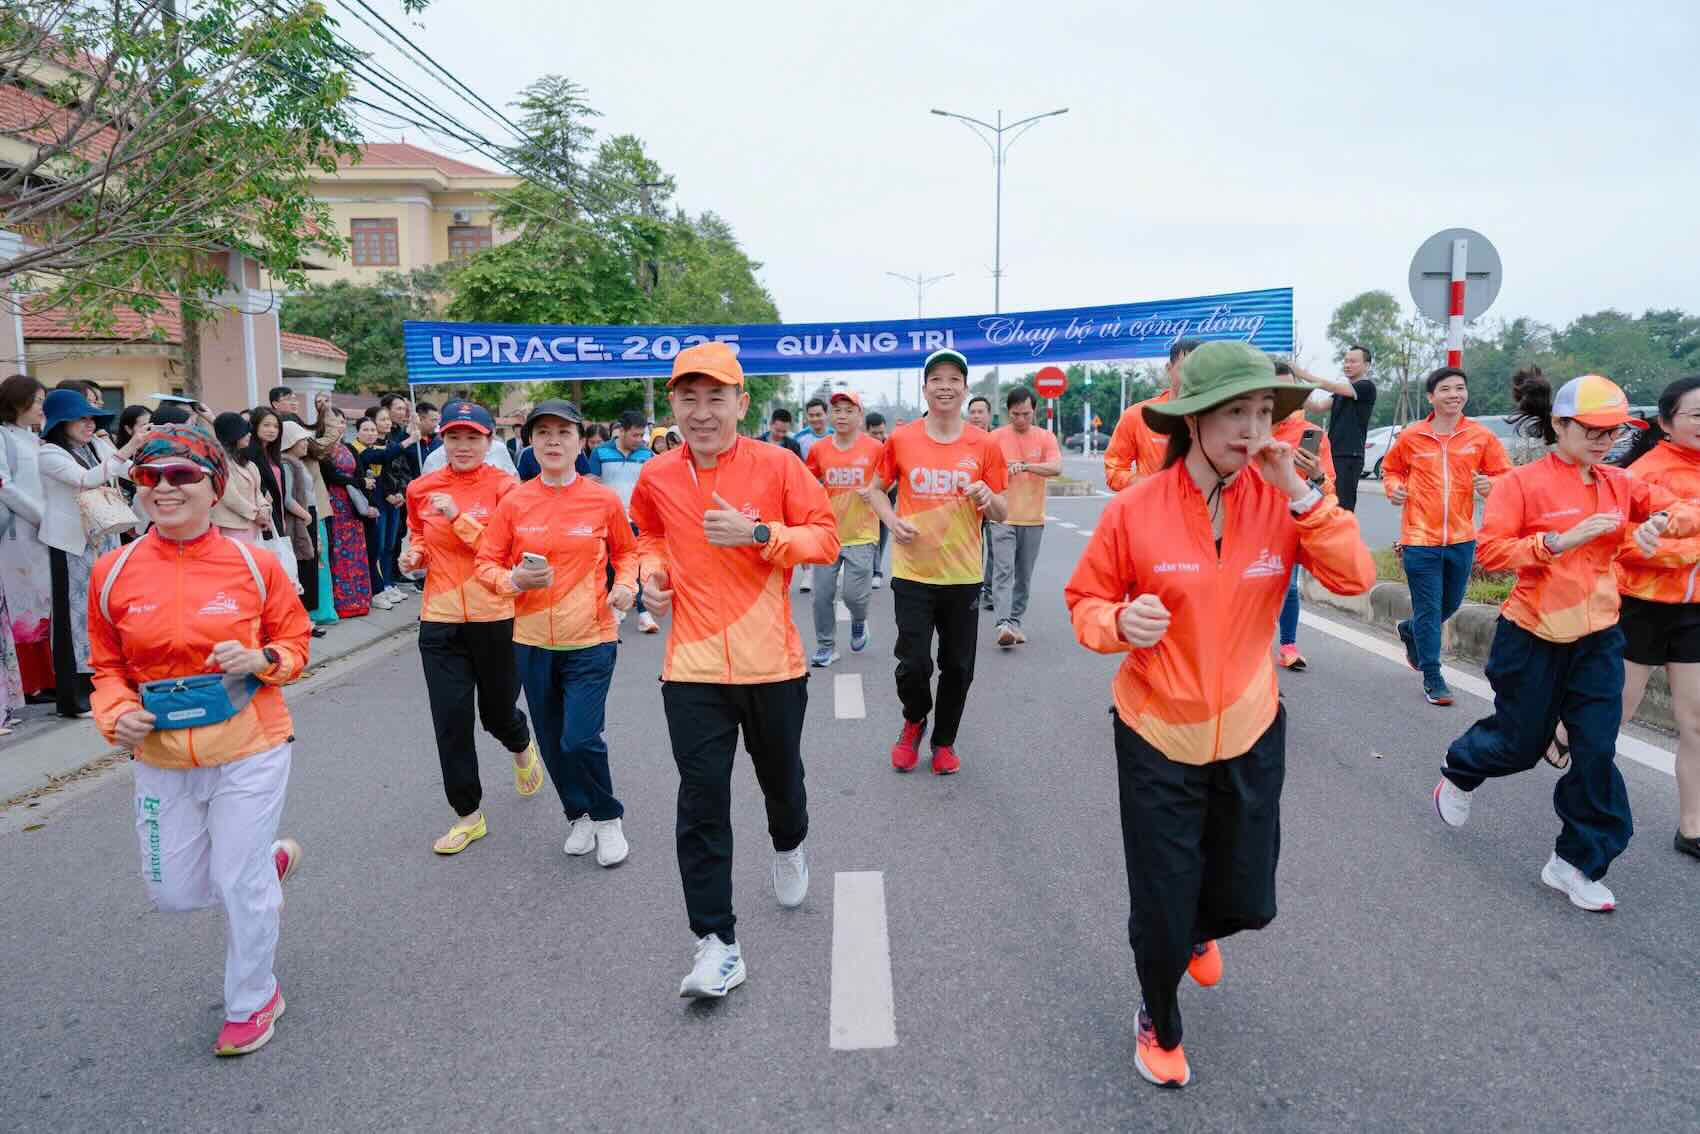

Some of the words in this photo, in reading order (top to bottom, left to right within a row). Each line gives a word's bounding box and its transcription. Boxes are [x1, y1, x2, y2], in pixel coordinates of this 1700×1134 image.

[776, 329, 898, 356] QUẢNG
[977, 316, 1058, 356] Chạy
[1064, 315, 1097, 344] bộ
[1099, 311, 1122, 337] vì
[1129, 312, 1191, 350] cộng
[1198, 303, 1265, 343] đồng
